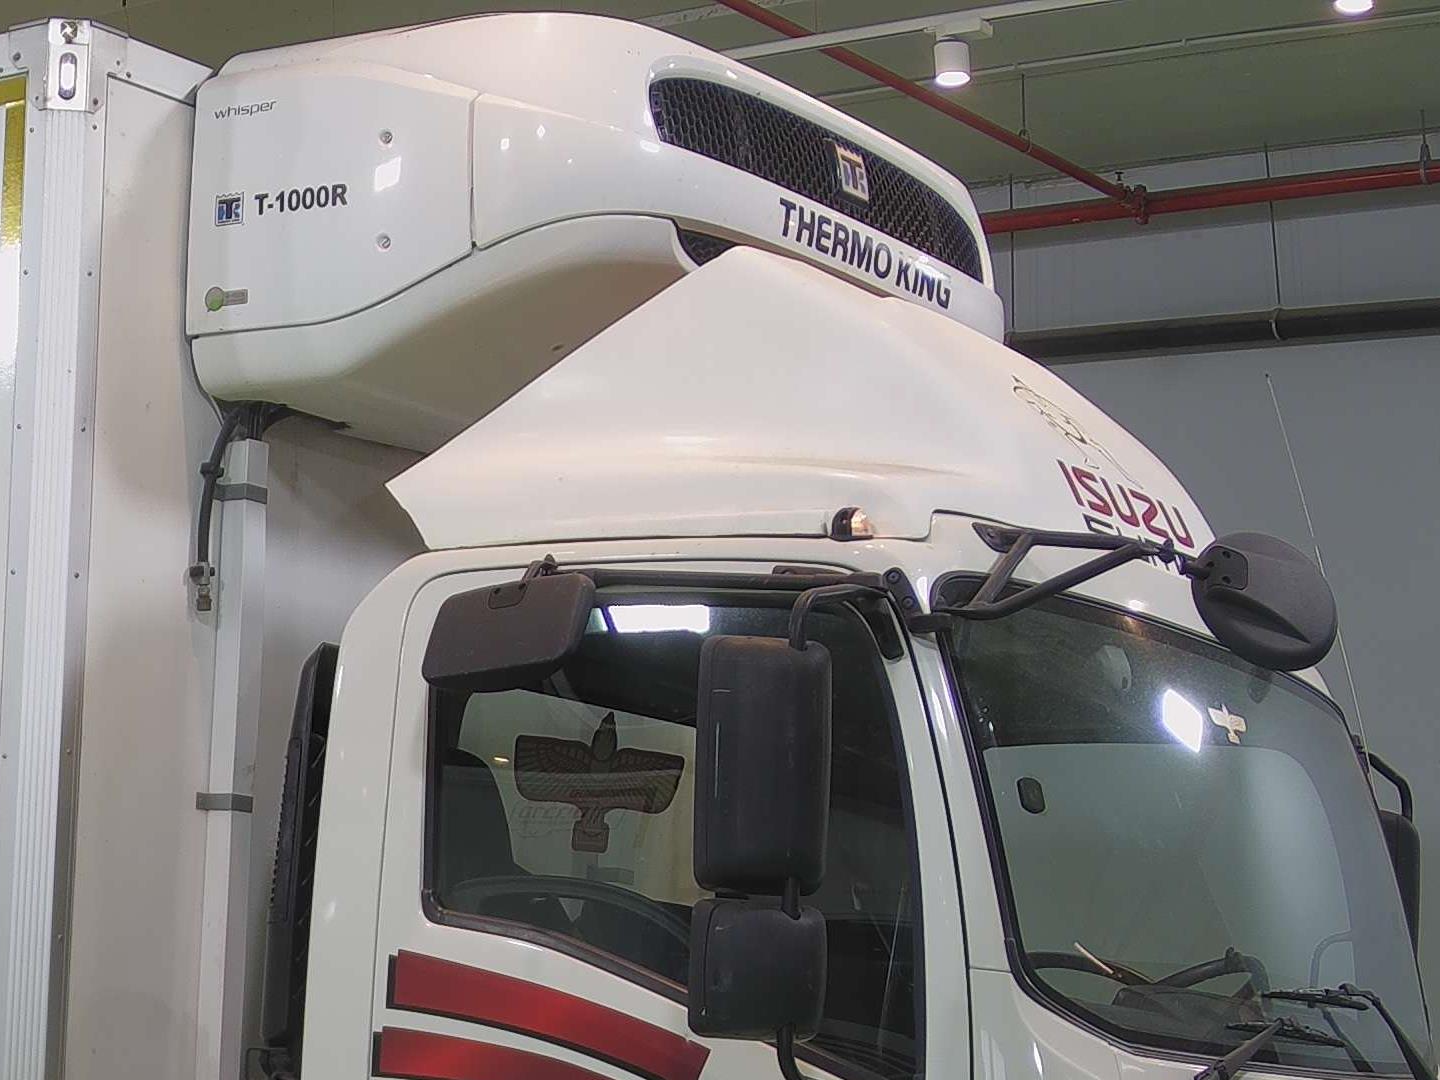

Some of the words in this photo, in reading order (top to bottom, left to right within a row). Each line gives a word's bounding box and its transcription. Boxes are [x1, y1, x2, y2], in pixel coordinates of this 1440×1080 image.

[214, 99, 277, 120] whisper
[253, 183, 348, 215] T-1000R
[779, 196, 893, 279] THERMO
[895, 255, 952, 309] KING
[1055, 459, 1196, 549] ISUZU
